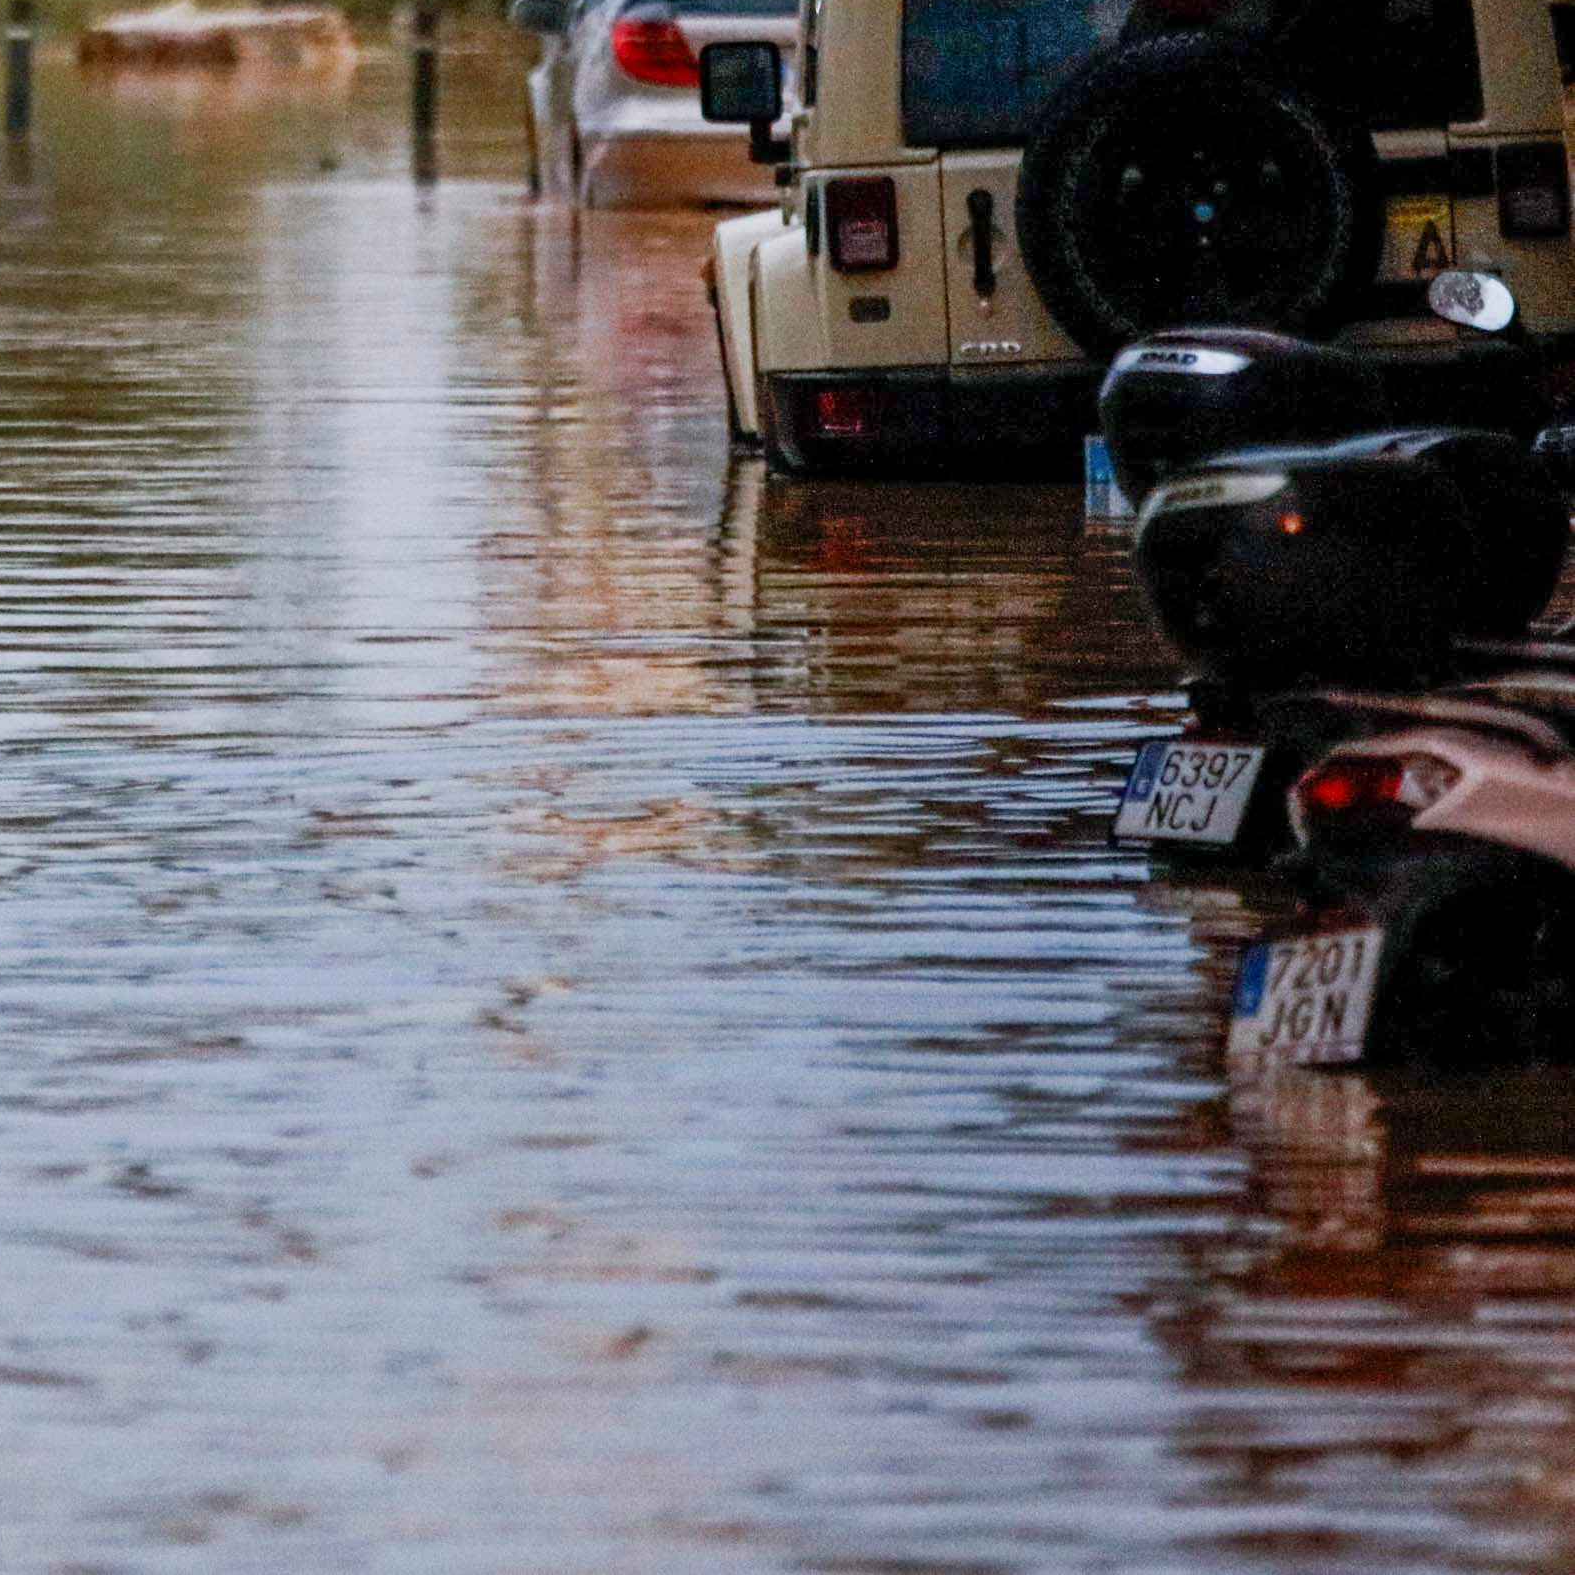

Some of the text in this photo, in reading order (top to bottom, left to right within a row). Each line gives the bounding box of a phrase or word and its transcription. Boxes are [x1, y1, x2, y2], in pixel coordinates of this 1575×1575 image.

[1159, 749, 1253, 791] 6397
[1144, 791, 1218, 832] NCJ
[1271, 936, 1365, 993] 7201
[1259, 991, 1349, 1046] JGN
